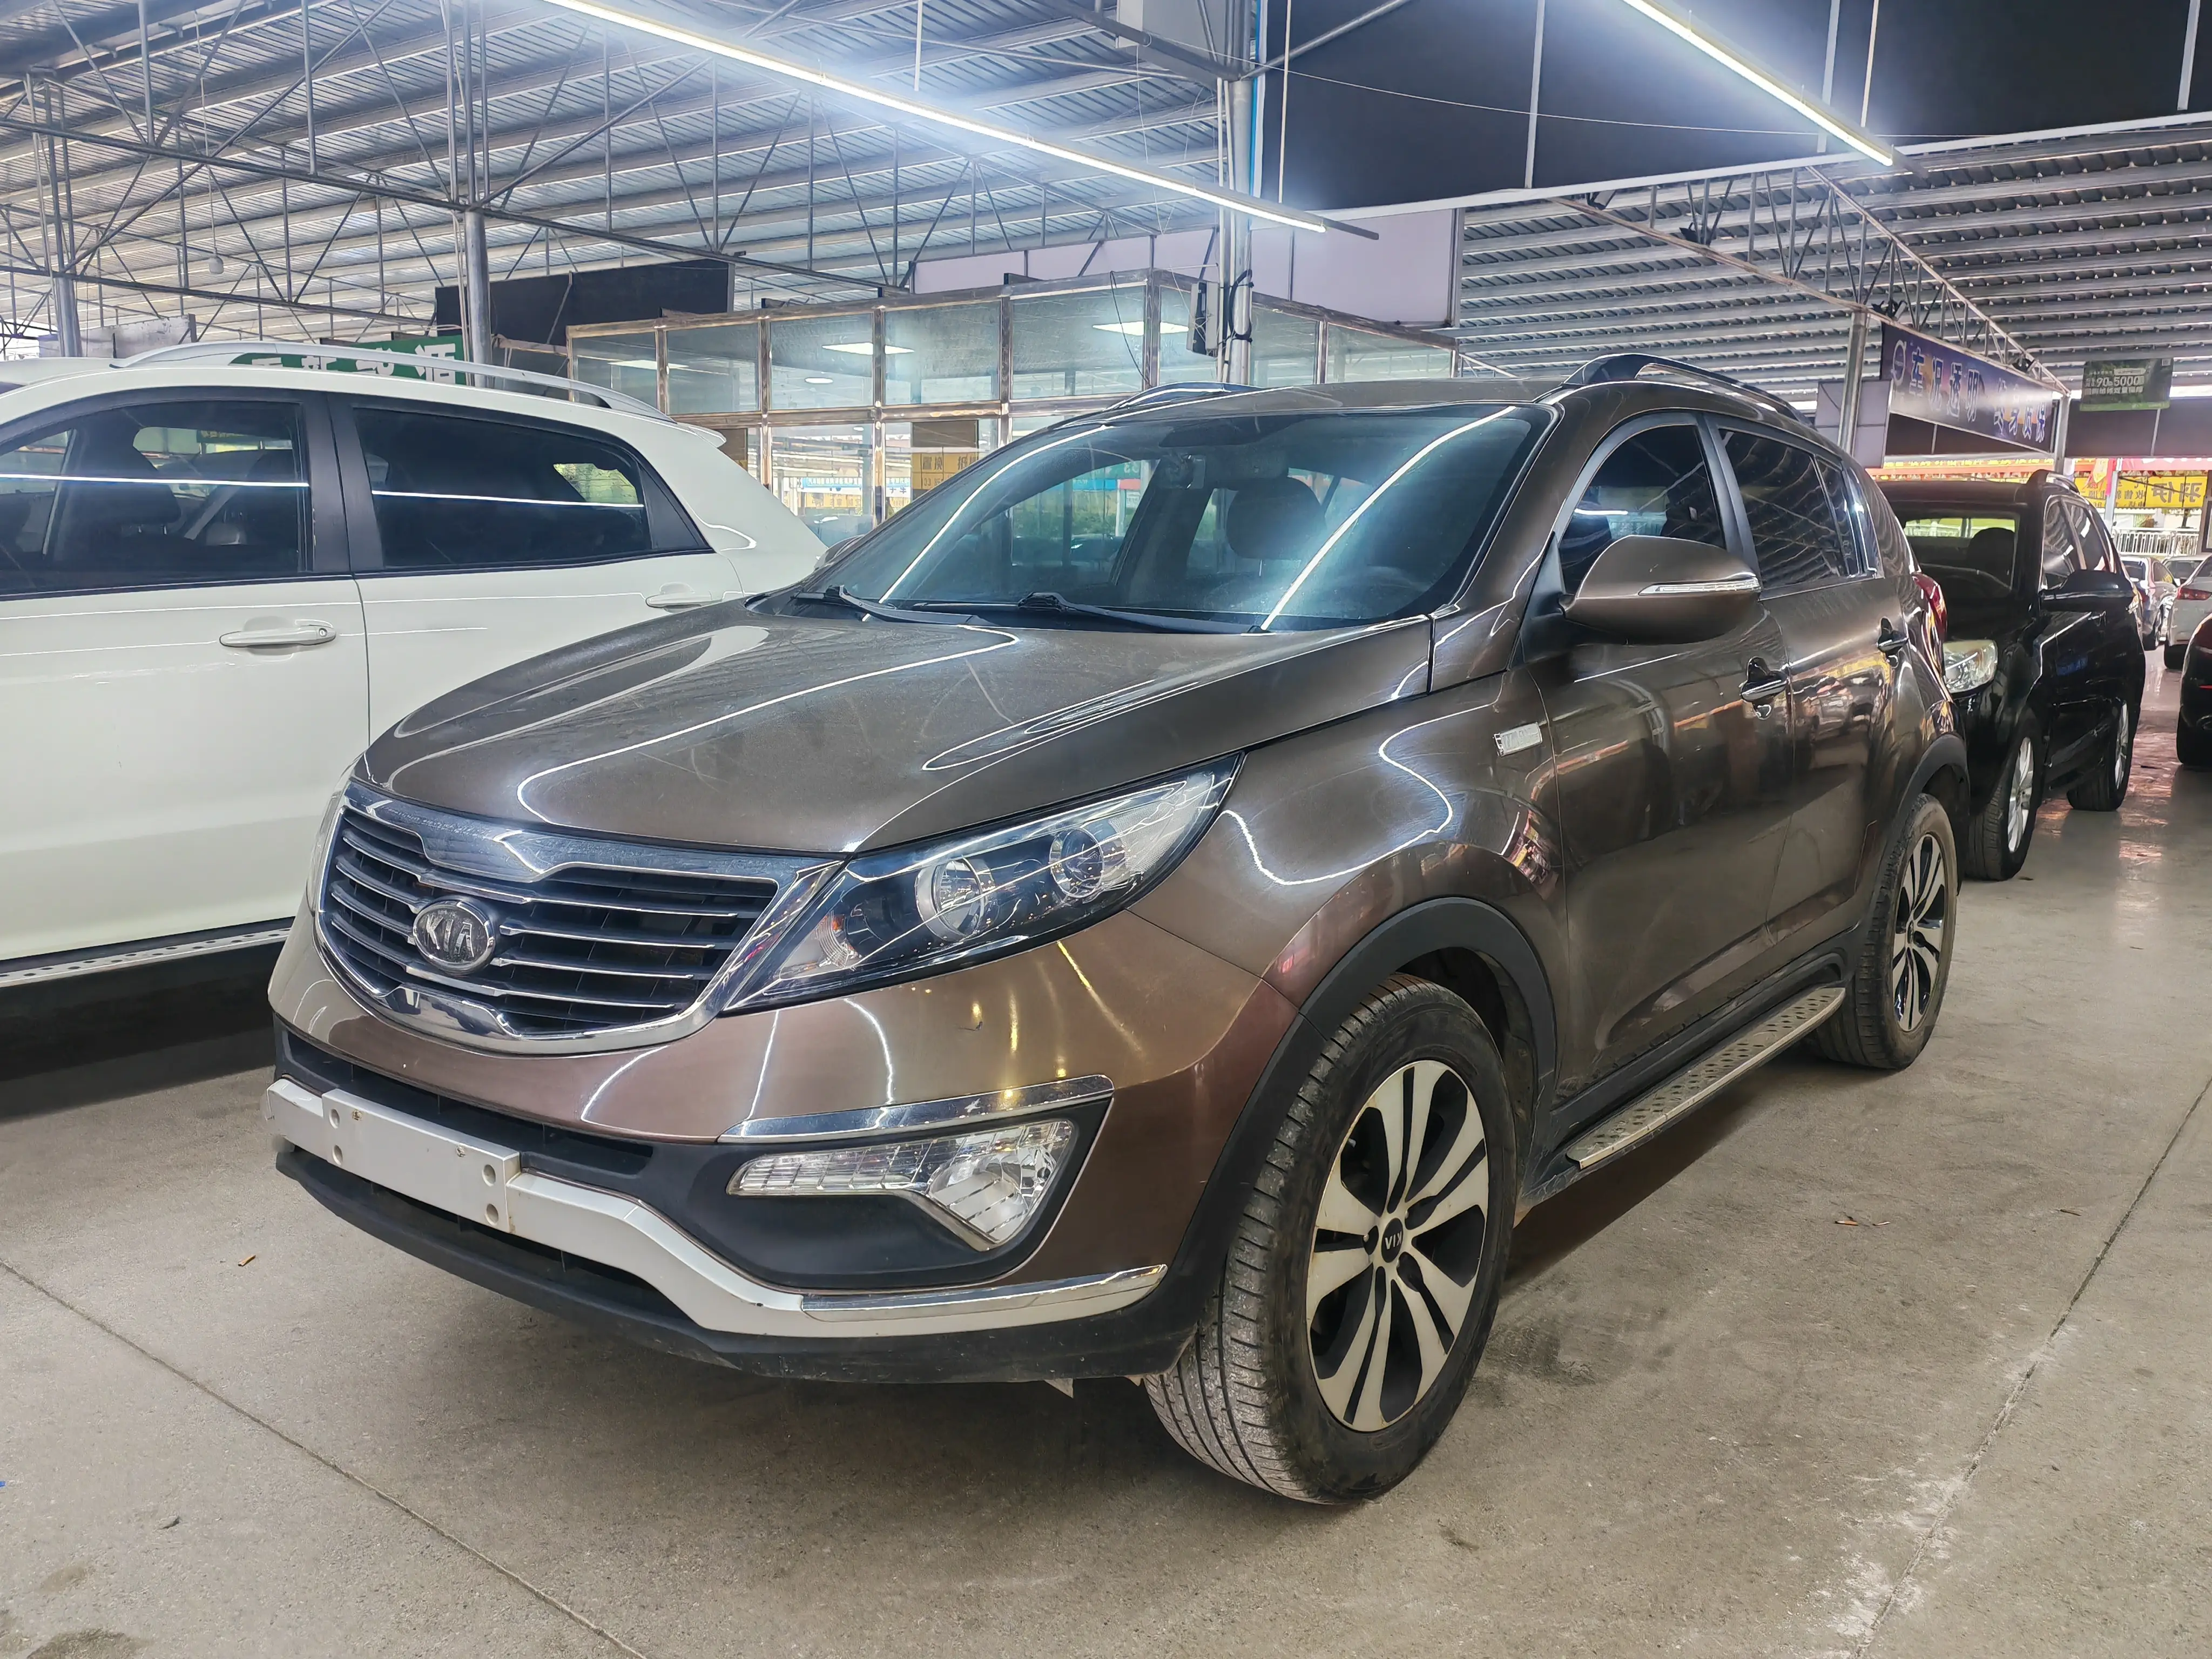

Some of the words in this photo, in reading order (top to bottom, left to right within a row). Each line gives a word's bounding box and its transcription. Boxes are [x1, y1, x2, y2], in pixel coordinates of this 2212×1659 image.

[1908, 347, 1982, 422] 车况透明
[425, 913, 474, 957] KIA
[1385, 1231, 1402, 1250] KIA
